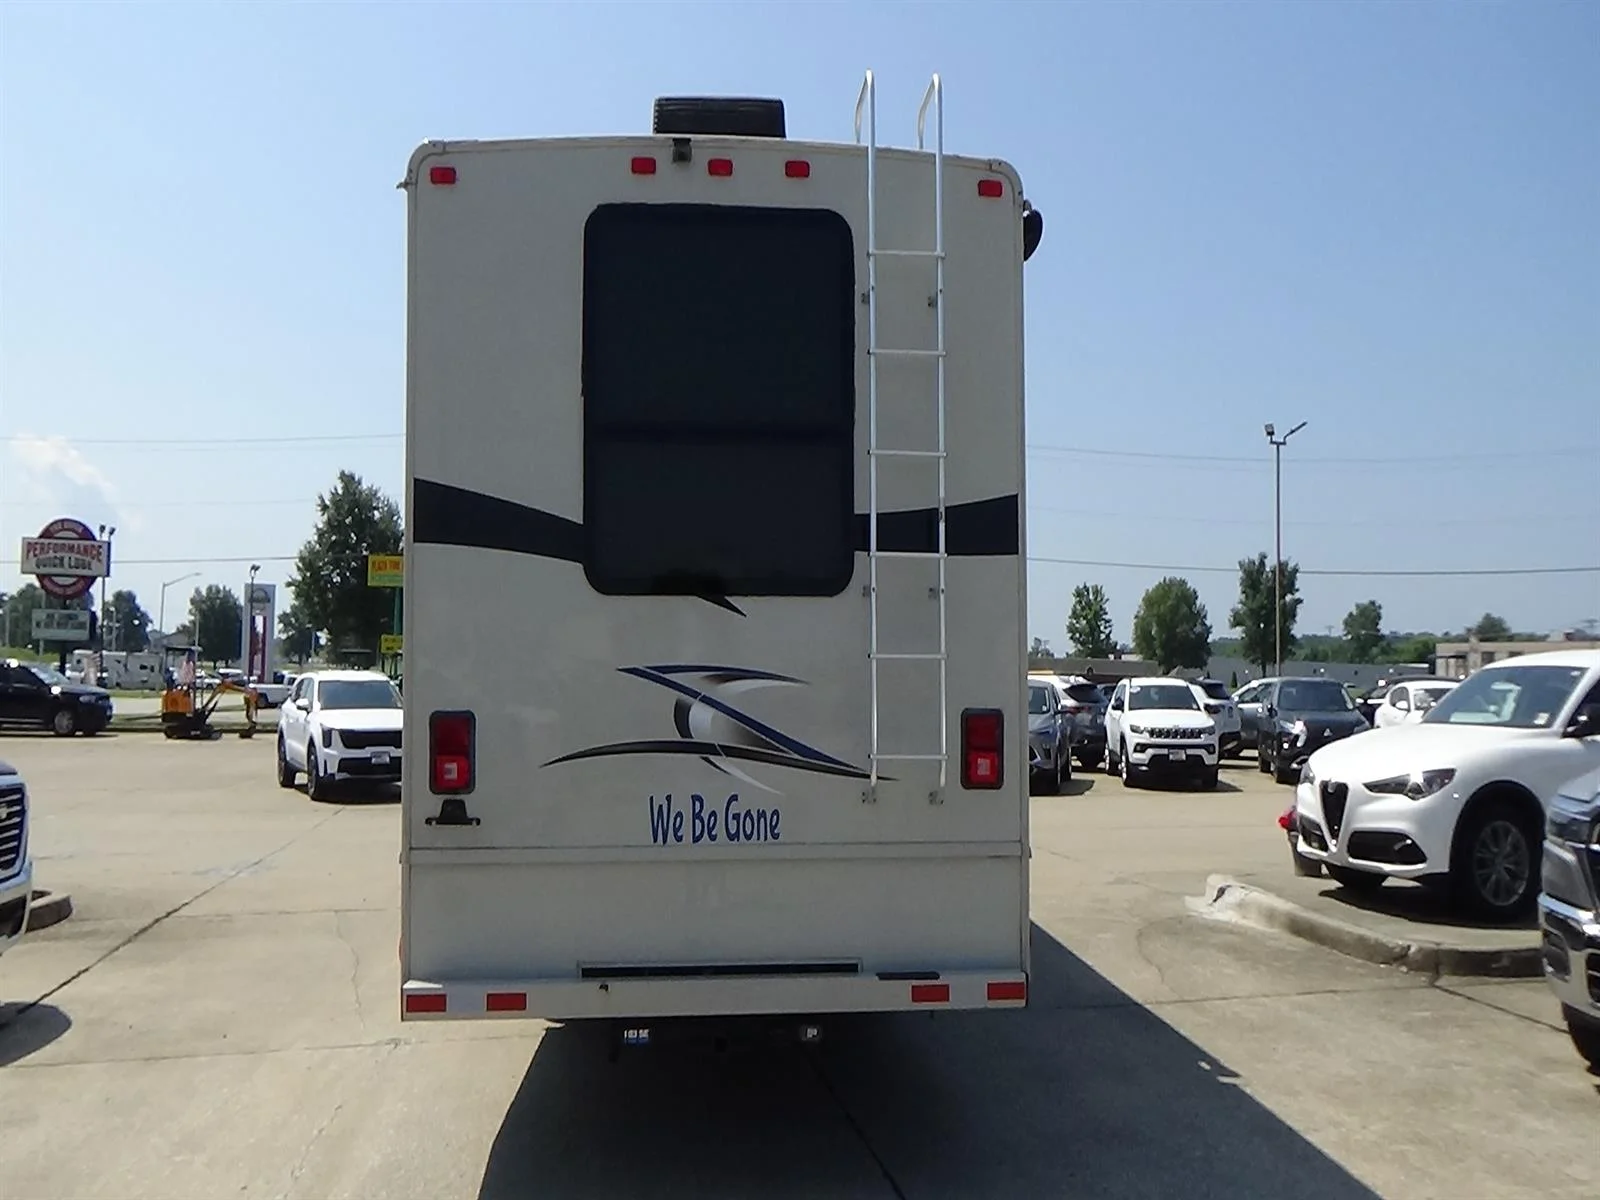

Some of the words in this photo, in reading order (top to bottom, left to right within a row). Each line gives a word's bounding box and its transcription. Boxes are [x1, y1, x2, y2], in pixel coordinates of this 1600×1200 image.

[26, 541, 103, 563] PERFORMANCE
[35, 555, 65, 570] QUICK
[68, 556, 93, 571] LUBE
[649, 794, 684, 845] We
[690, 794, 718, 844] Be
[724, 794, 780, 842] Gone
